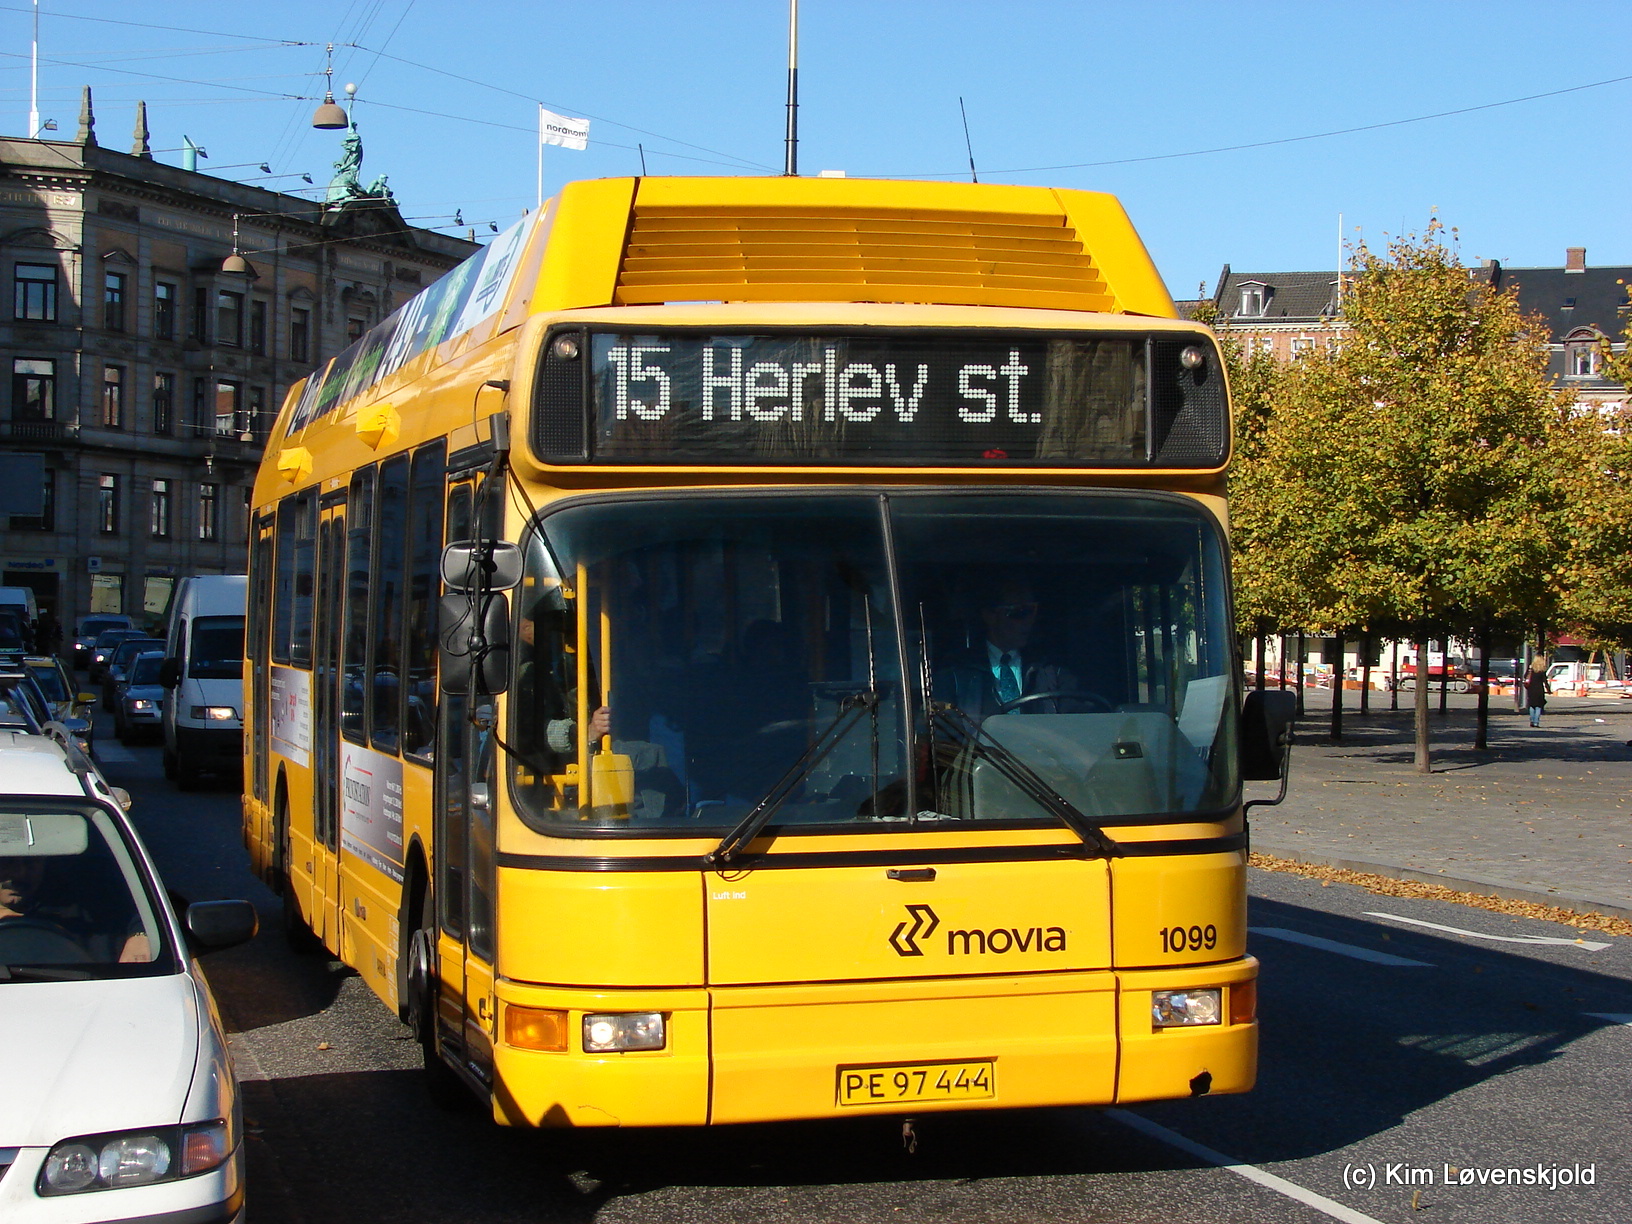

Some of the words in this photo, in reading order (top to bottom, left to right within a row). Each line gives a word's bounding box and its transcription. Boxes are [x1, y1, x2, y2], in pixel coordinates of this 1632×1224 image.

[607, 346, 671, 421] 15
[702, 347, 928, 422] Herlev
[958, 347, 1041, 424] st.
[713, 890, 731, 901] Luft
[732, 890, 746, 900] ind
[948, 926, 1067, 955] movia
[1159, 924, 1218, 953] 1099
[846, 1073, 886, 1099] PE
[893, 1071, 928, 1097] 97
[935, 1067, 989, 1093] 444
